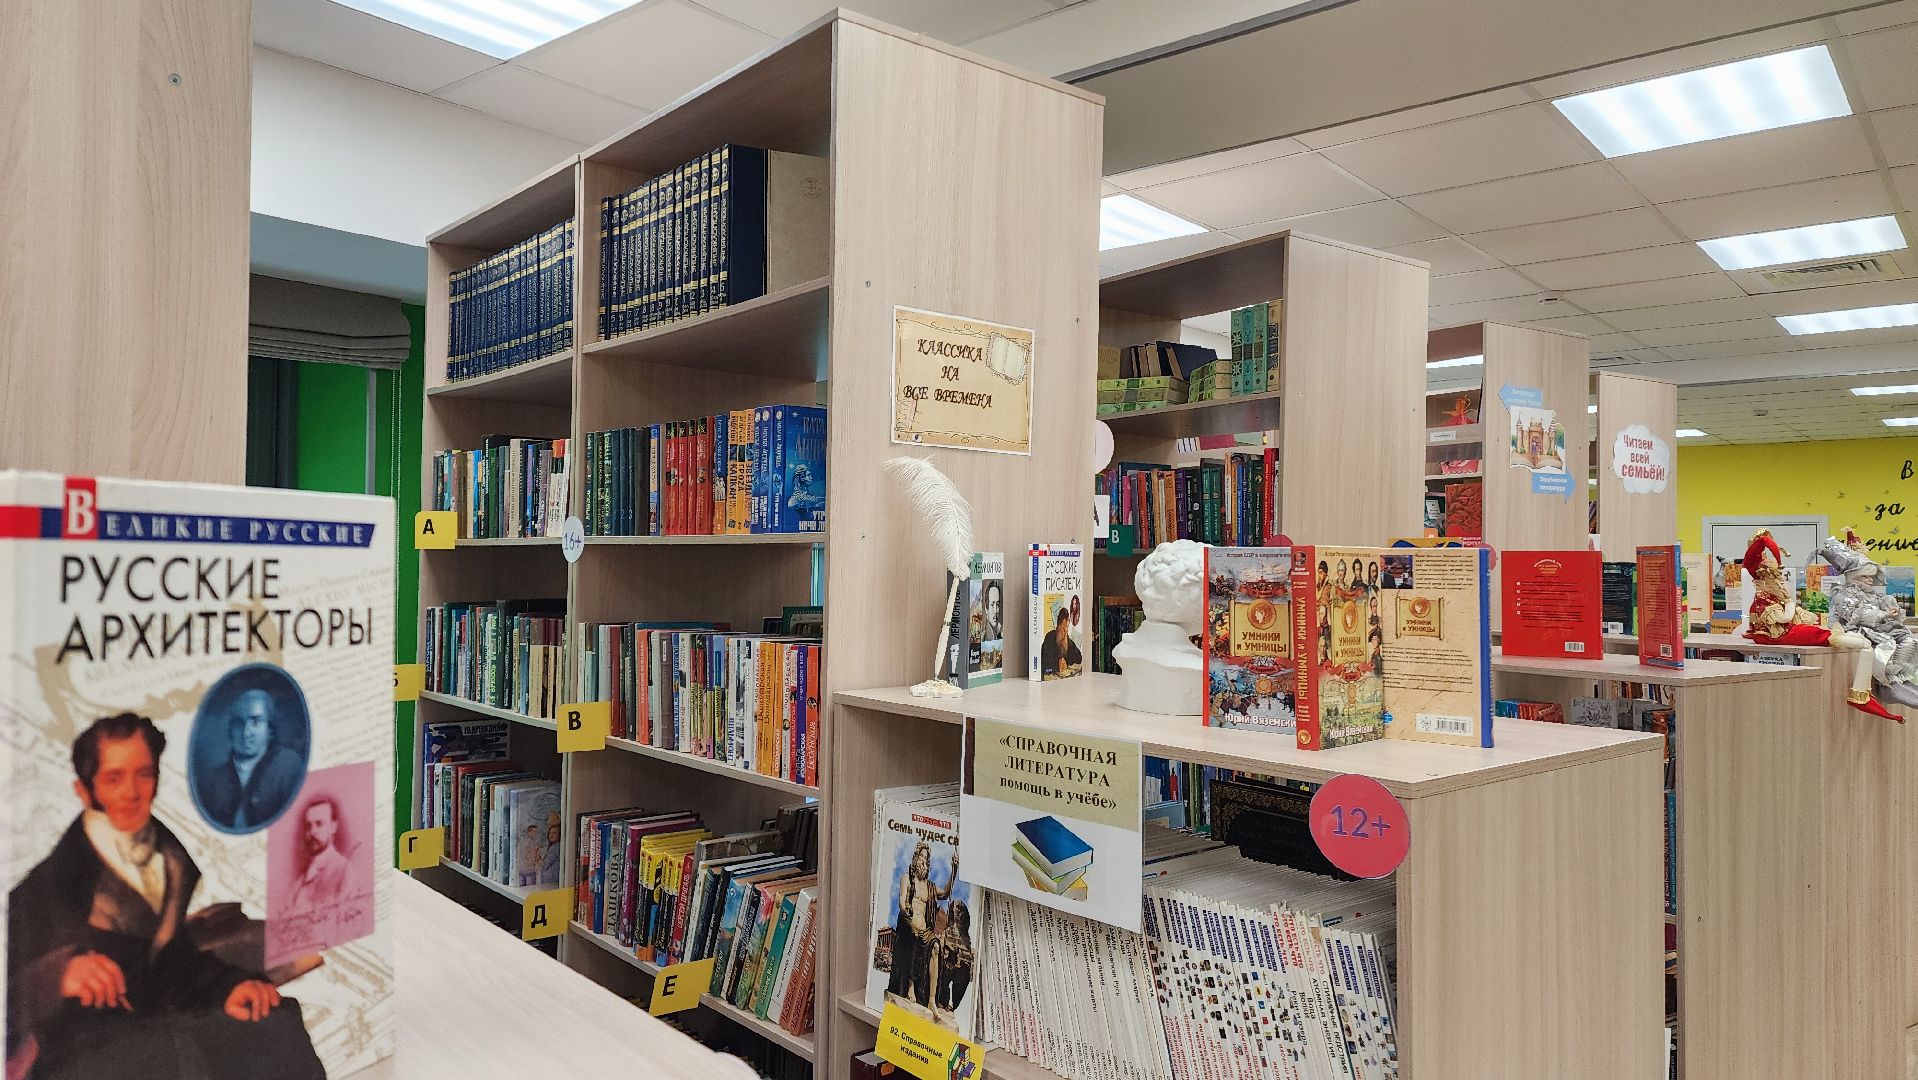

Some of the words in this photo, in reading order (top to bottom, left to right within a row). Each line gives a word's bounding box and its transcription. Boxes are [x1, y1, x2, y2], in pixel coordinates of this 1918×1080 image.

[917, 339, 983, 362] КЛАССИКА
[941, 365, 960, 381] НА
[903, 385, 929, 400] ВСЕ
[933, 388, 993, 409] ВРЕМЕНА
[1623, 434, 1654, 451] Читаем
[1630, 451, 1650, 465] всей
[1875, 502, 1906, 521] за
[248, 519, 366, 545] РУССКИЕ
[422, 518, 435, 535] А
[60, 554, 281, 604] РУССКИЕ
[1045, 560, 1078, 575] РУССКИЕ
[55, 605, 374, 666] АРХИТЕКТОРЫ
[1241, 631, 1281, 643] УМНИКИ
[1244, 642, 1288, 654] УМНИЦЫ
[568, 710, 582, 731] В
[999, 734, 1118, 766] «СПРАВОЧНАЯ
[1004, 755, 1111, 788] ЛИТЕРАТУРА
[1000, 776, 1051, 798] помощь
[1054, 787, 1064, 799] в
[1066, 788, 1118, 811] учёбе»
[887, 818, 913, 836] Семь
[915, 826, 946, 844] чудес
[1329, 804, 1391, 839] 12+
[408, 836, 418, 853] Г
[530, 904, 547, 929] Д
[662, 974, 678, 997] Е
[889, 1026, 900, 1037] 92.
[901, 1032, 943, 1059] Справочные
[900, 1045, 929, 1065] издания
